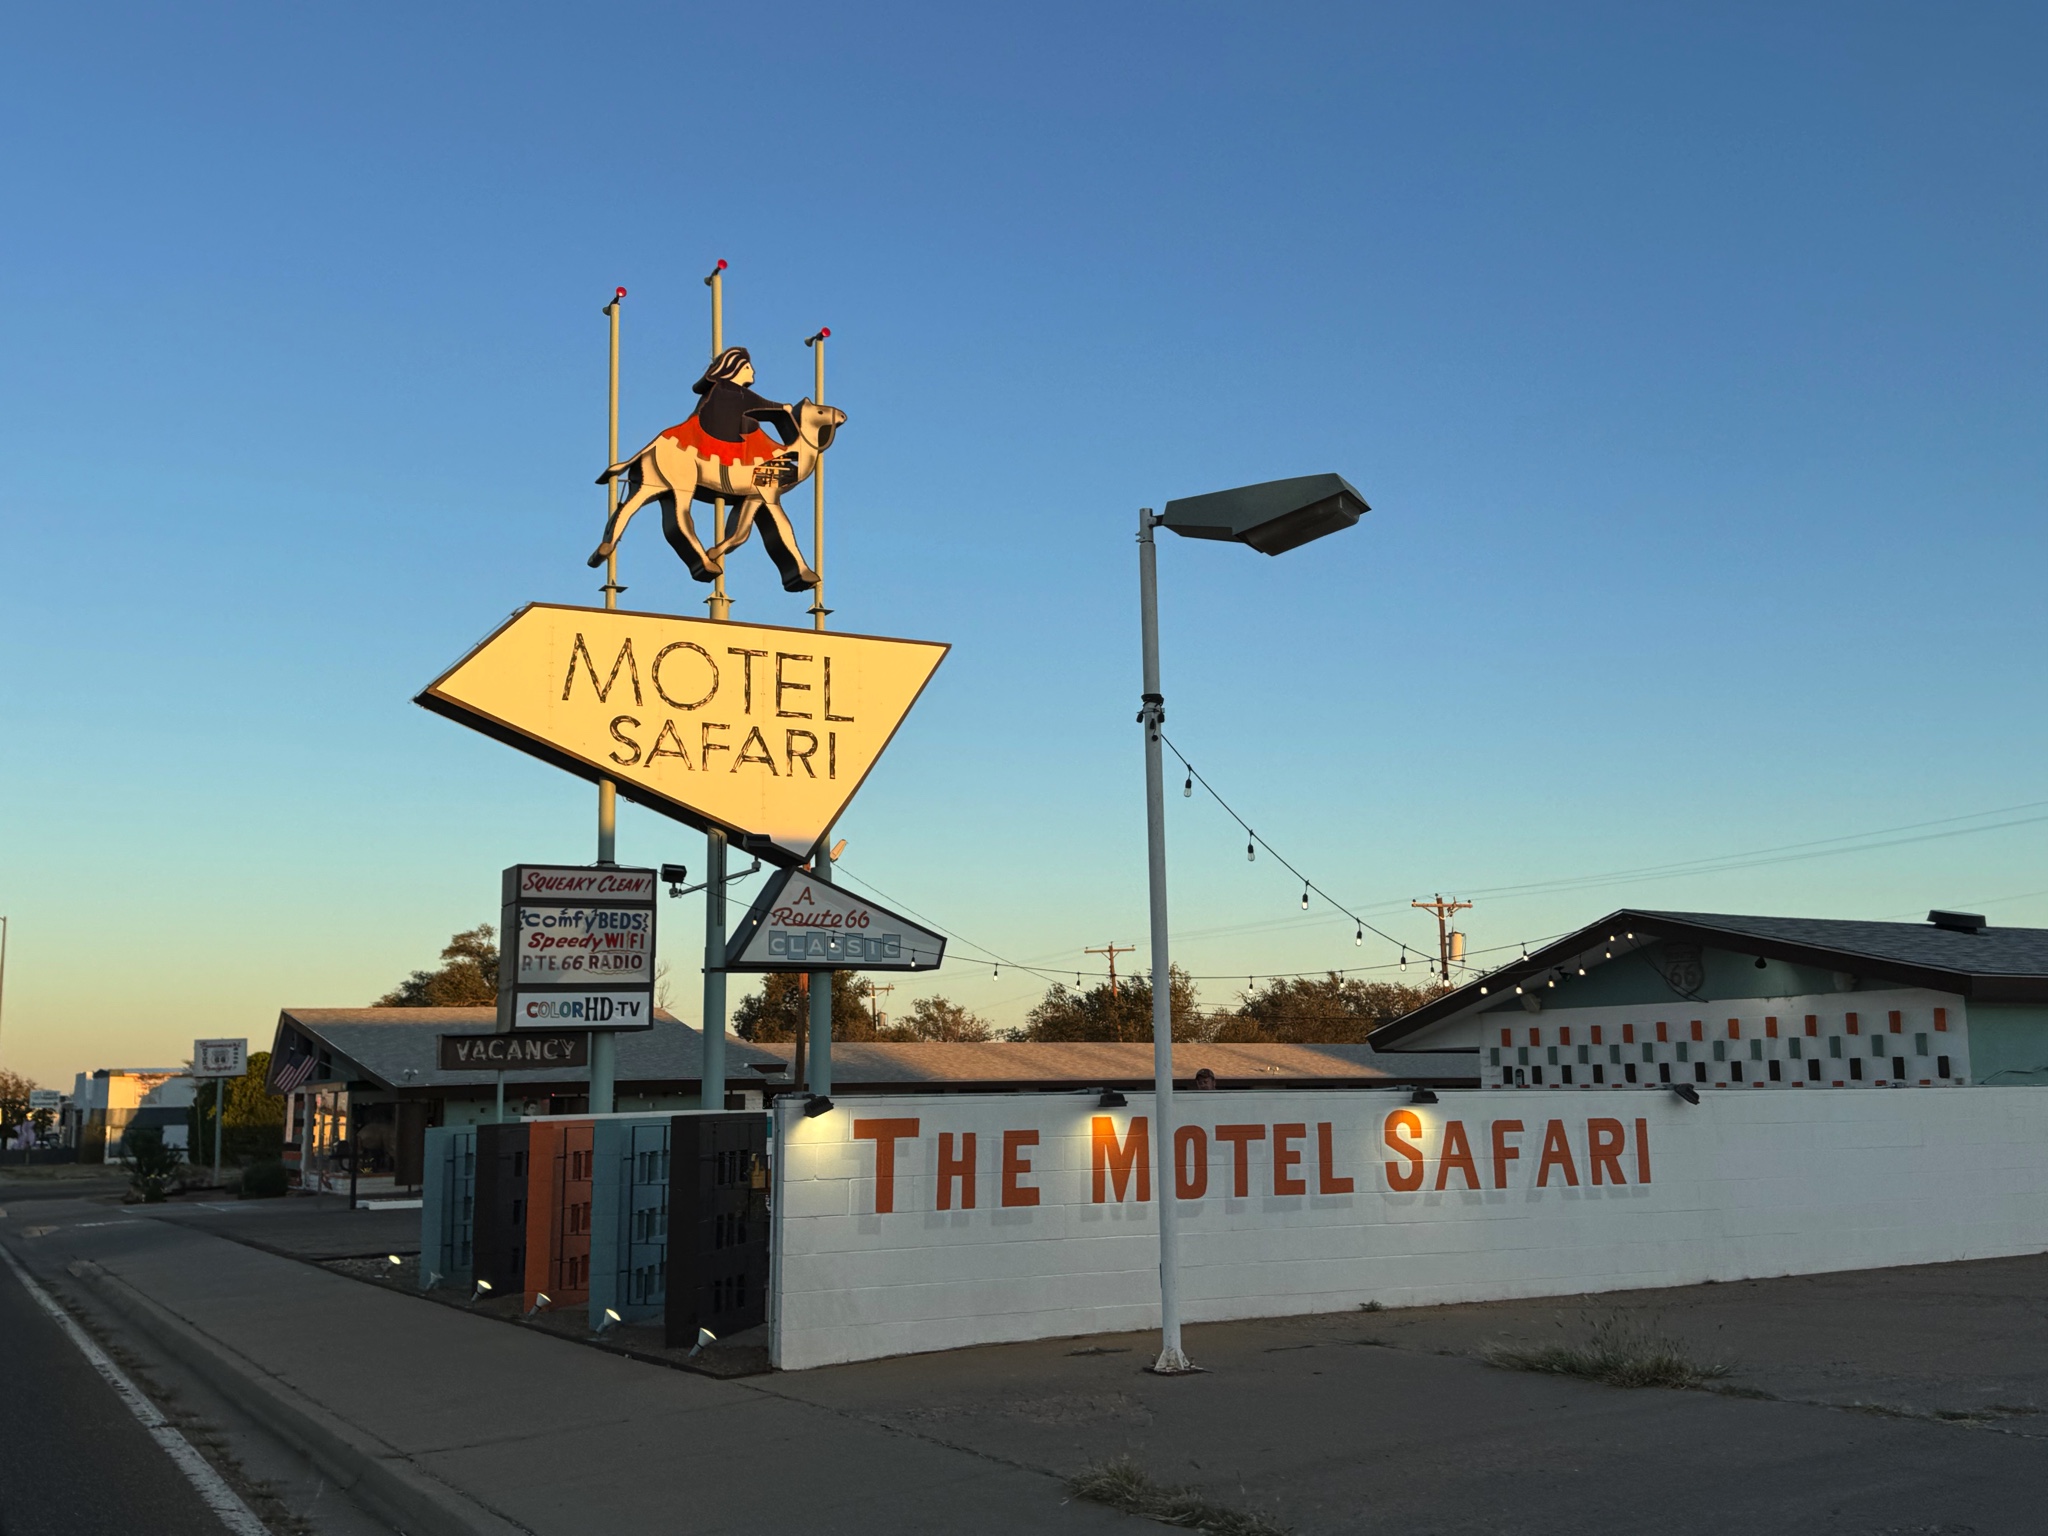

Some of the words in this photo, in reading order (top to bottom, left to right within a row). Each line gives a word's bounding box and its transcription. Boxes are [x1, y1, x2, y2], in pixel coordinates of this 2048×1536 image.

[562, 633, 854, 723] MOTEL
[608, 715, 836, 780] SAFARI
[522, 872, 597, 892] SQUEAKY
[598, 876, 652, 893] CLEAN!
[793, 886, 815, 906] A
[771, 907, 842, 928] Route
[845, 909, 870, 929] 66
[528, 932, 604, 952] Speedy
[771, 936, 900, 955] CLASSIC
[588, 954, 643, 970] RADIO
[1670, 963, 1696, 986] 66
[526, 1002, 584, 1019] COLOR
[456, 1039, 576, 1062] VACANCY
[854, 1118, 1039, 1213] THE
[1092, 1116, 1353, 1203] MOTEL
[1385, 1109, 1649, 1192] SAFARI
